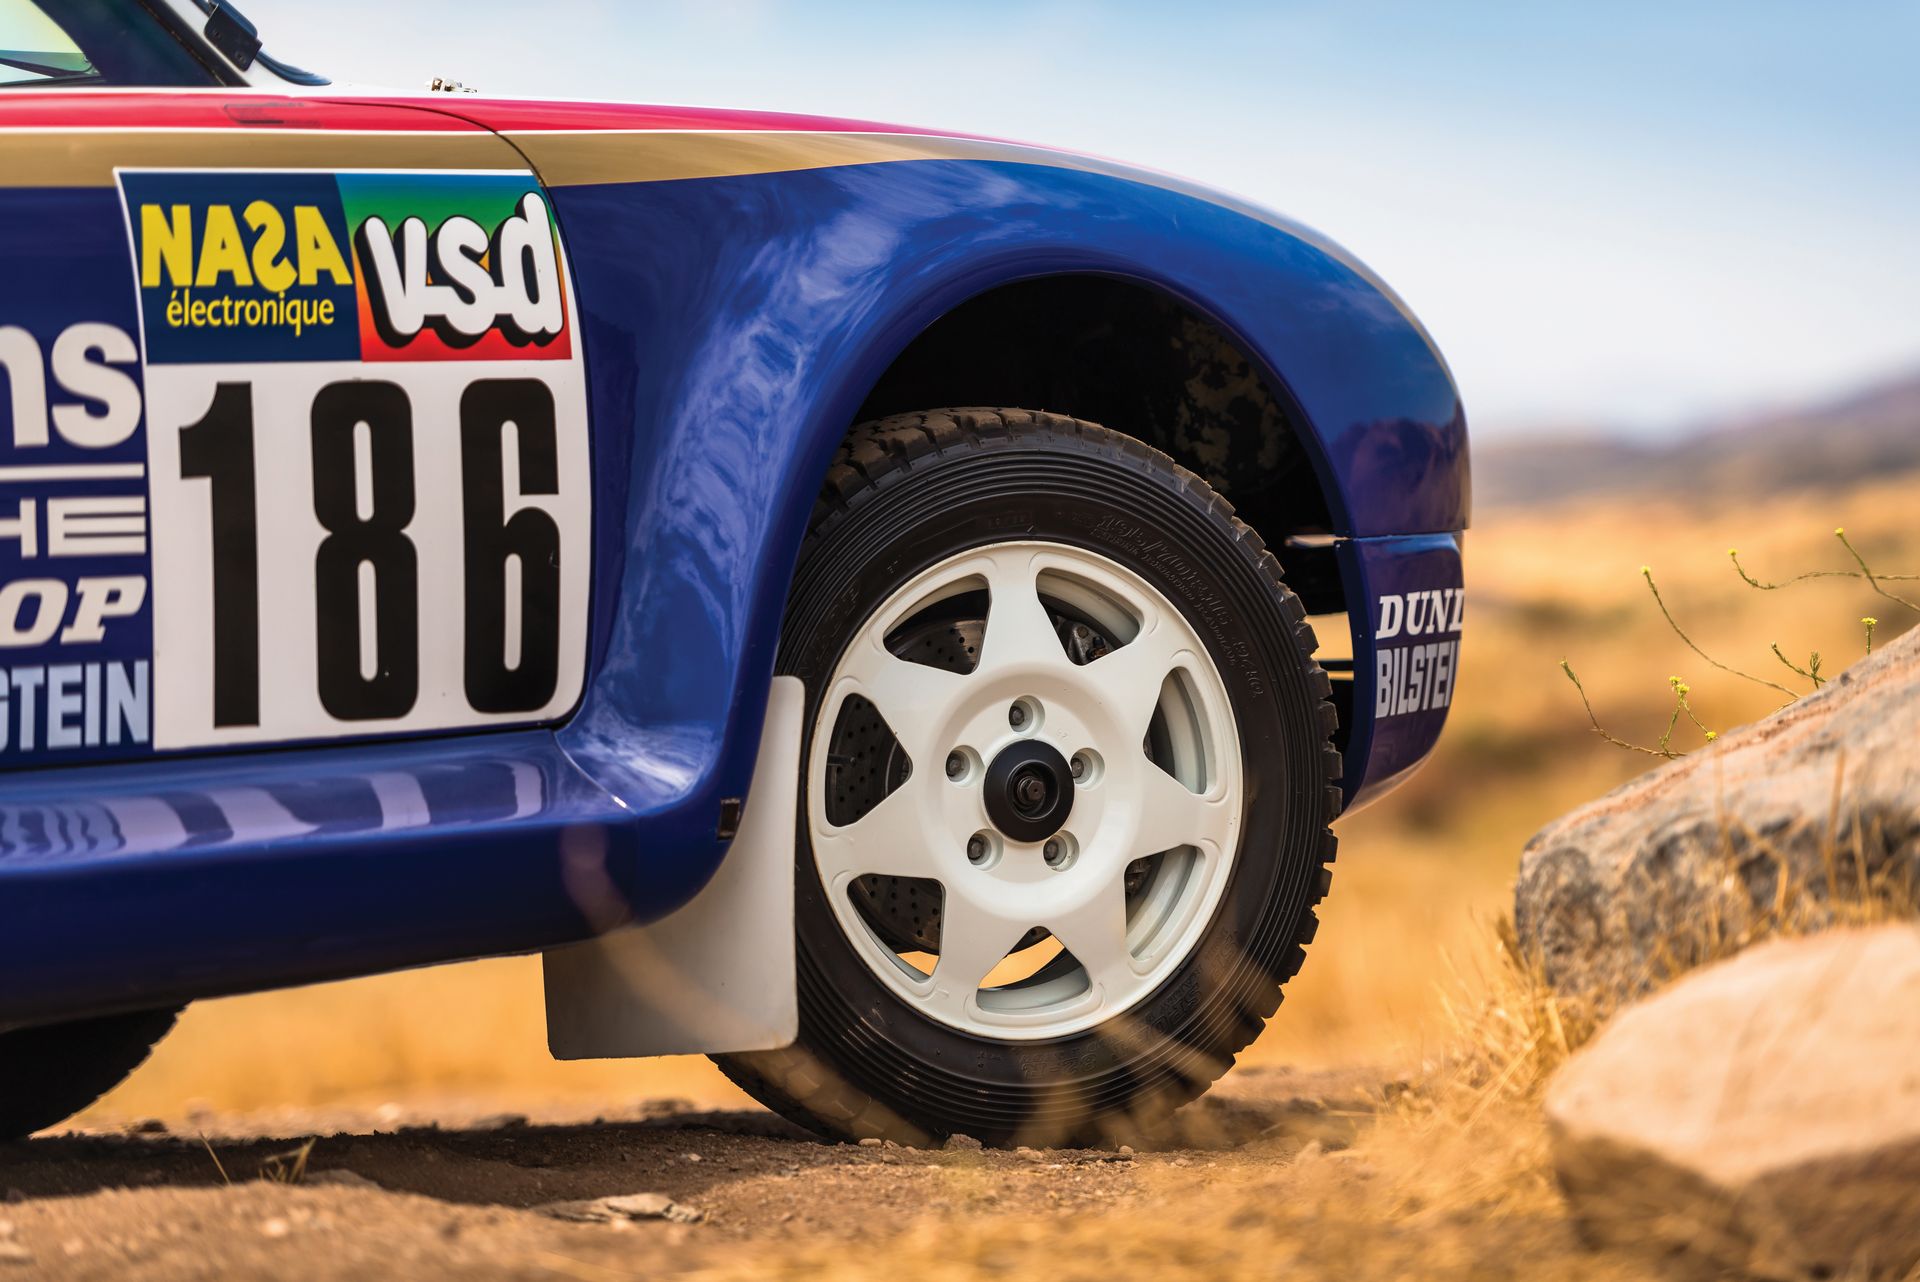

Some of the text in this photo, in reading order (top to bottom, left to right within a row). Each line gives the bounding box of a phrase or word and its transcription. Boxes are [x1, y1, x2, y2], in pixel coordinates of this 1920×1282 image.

[141, 200, 353, 292] NASA
[166, 291, 335, 336] électronique
[178, 377, 561, 729] 186
[0, 575, 147, 648] OP
[0, 660, 149, 751] TEIN
